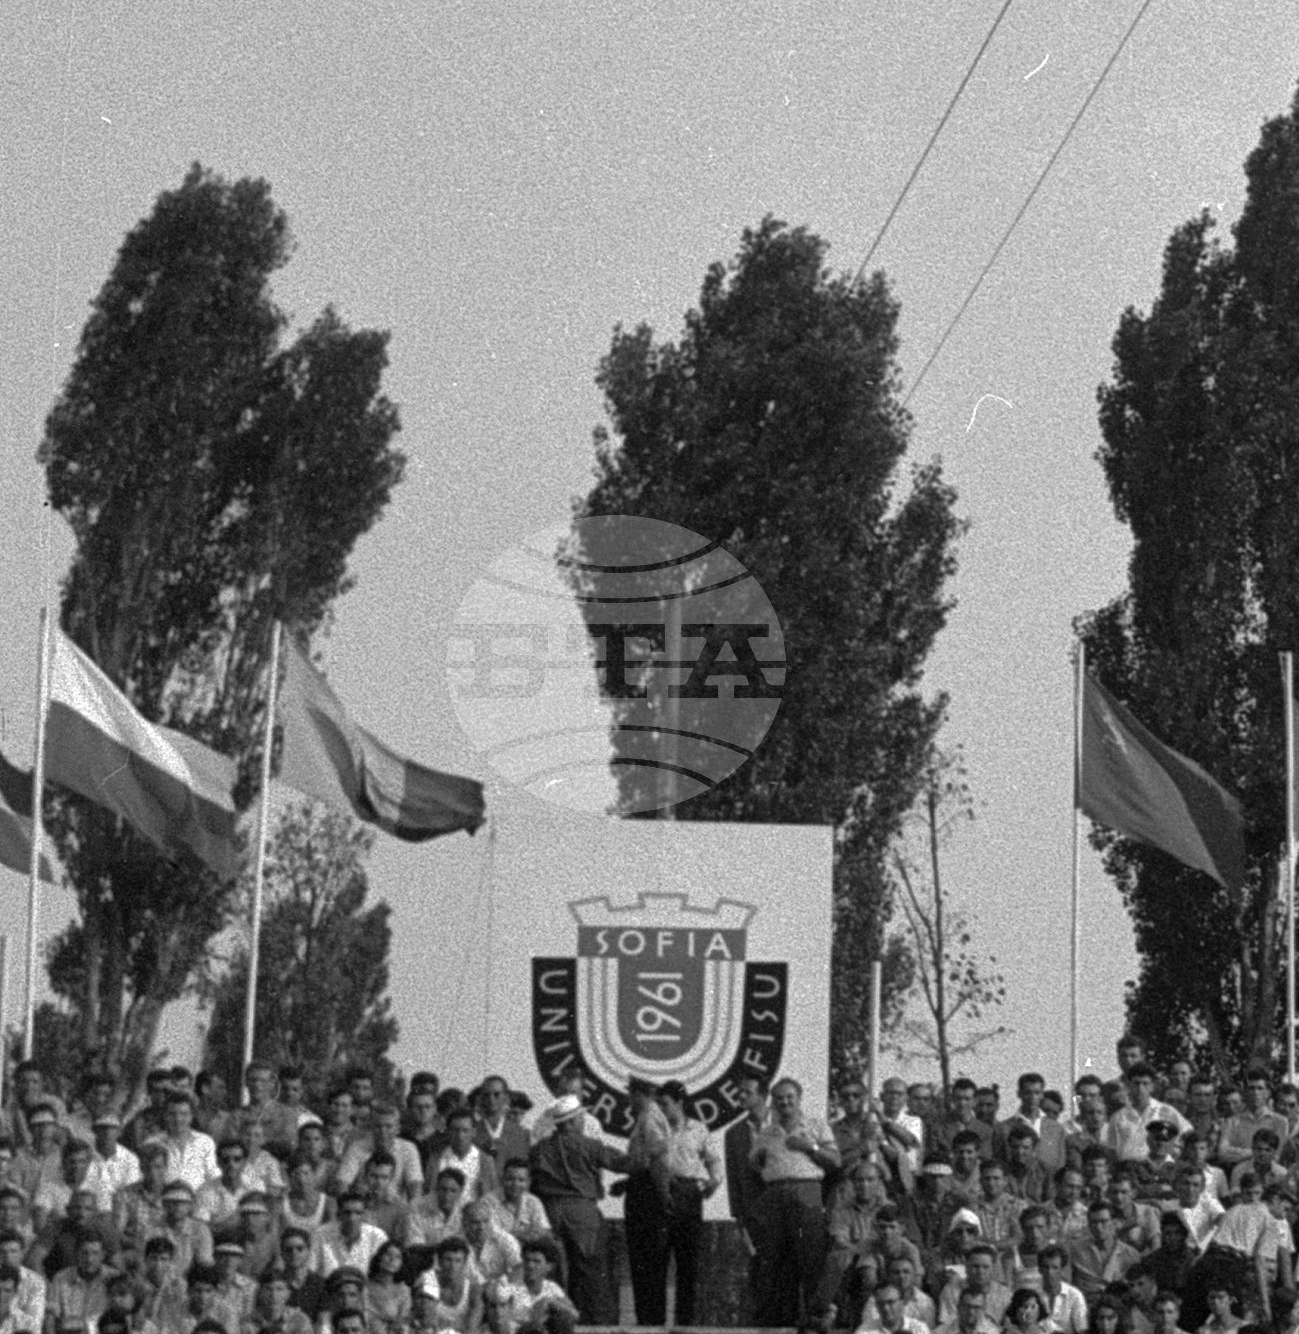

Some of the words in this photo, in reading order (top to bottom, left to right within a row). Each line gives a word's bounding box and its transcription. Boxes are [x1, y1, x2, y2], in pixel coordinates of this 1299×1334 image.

[596, 930, 732, 960] SOFIA
[635, 972, 683, 1041] 1961
[743, 974, 781, 1072] FISU
